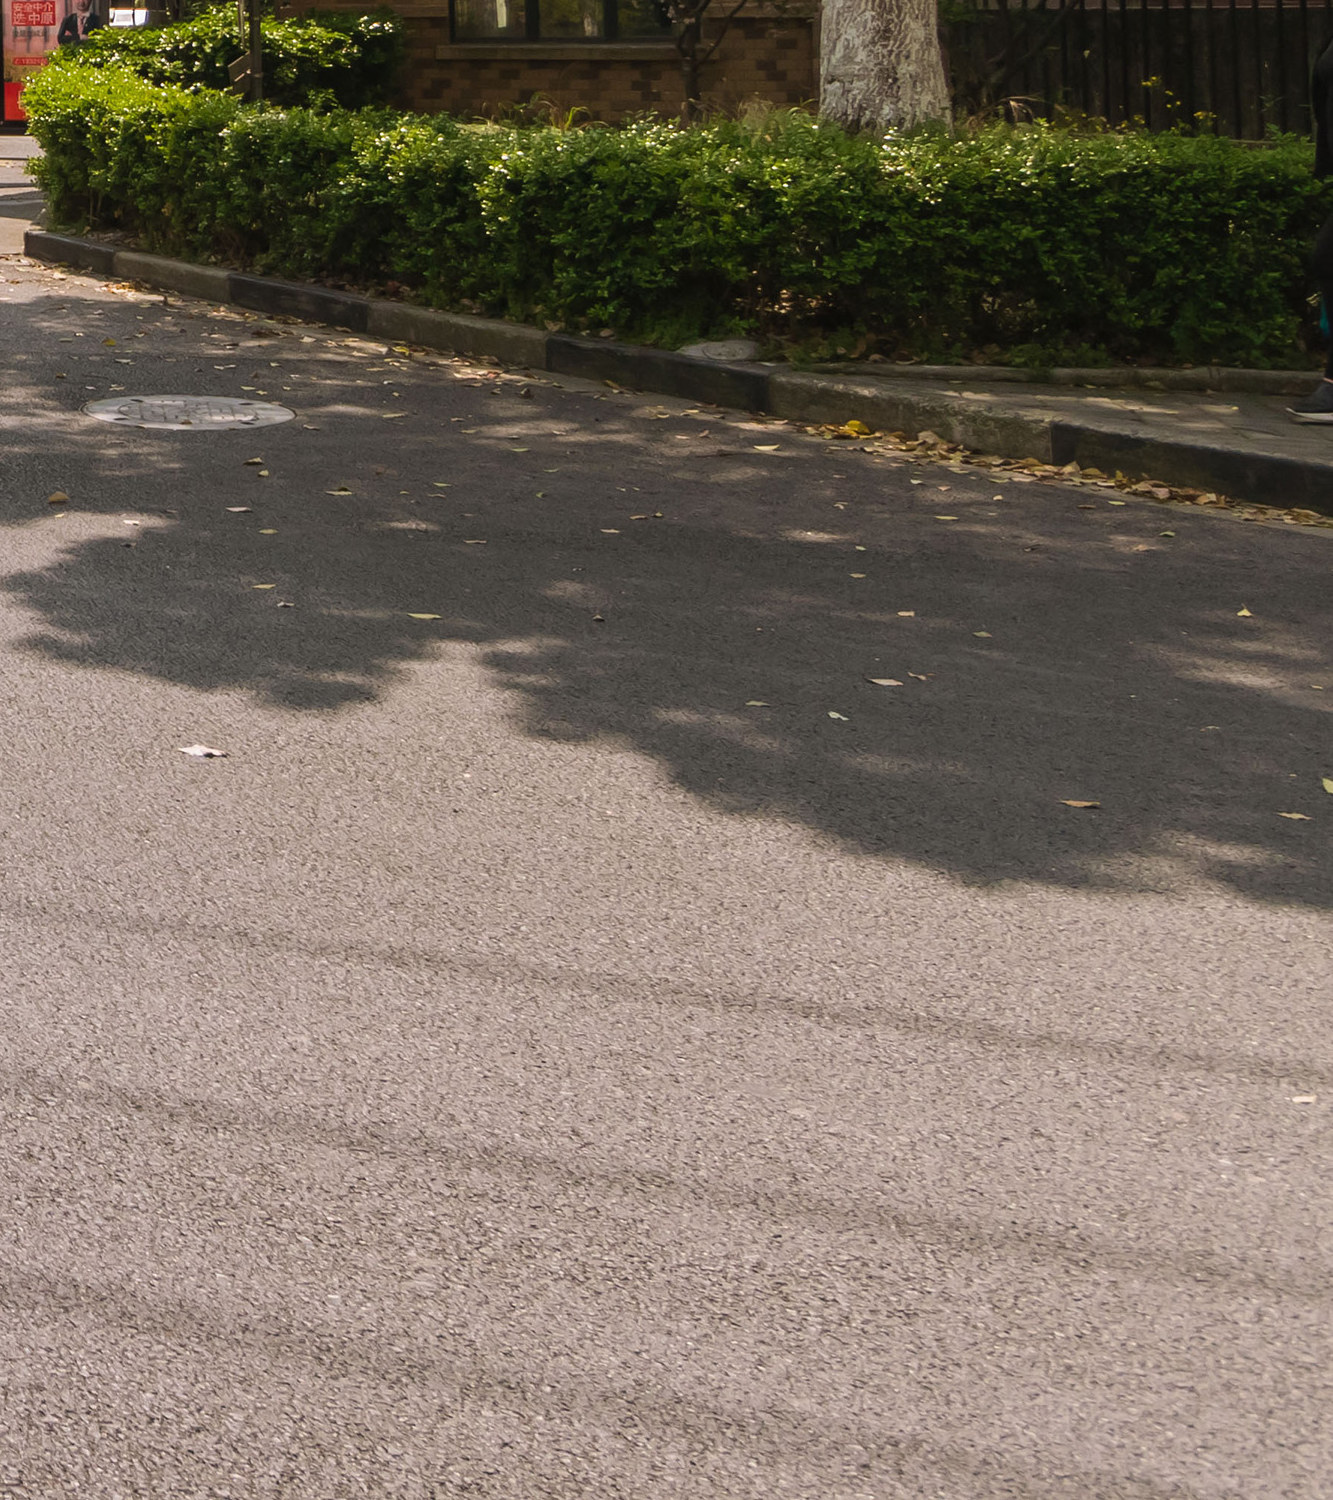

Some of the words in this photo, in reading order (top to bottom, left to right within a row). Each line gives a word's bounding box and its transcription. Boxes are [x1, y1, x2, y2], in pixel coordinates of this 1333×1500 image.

[13, 1, 53, 13] 安全中介
[13, 11, 54, 25] 选中原
